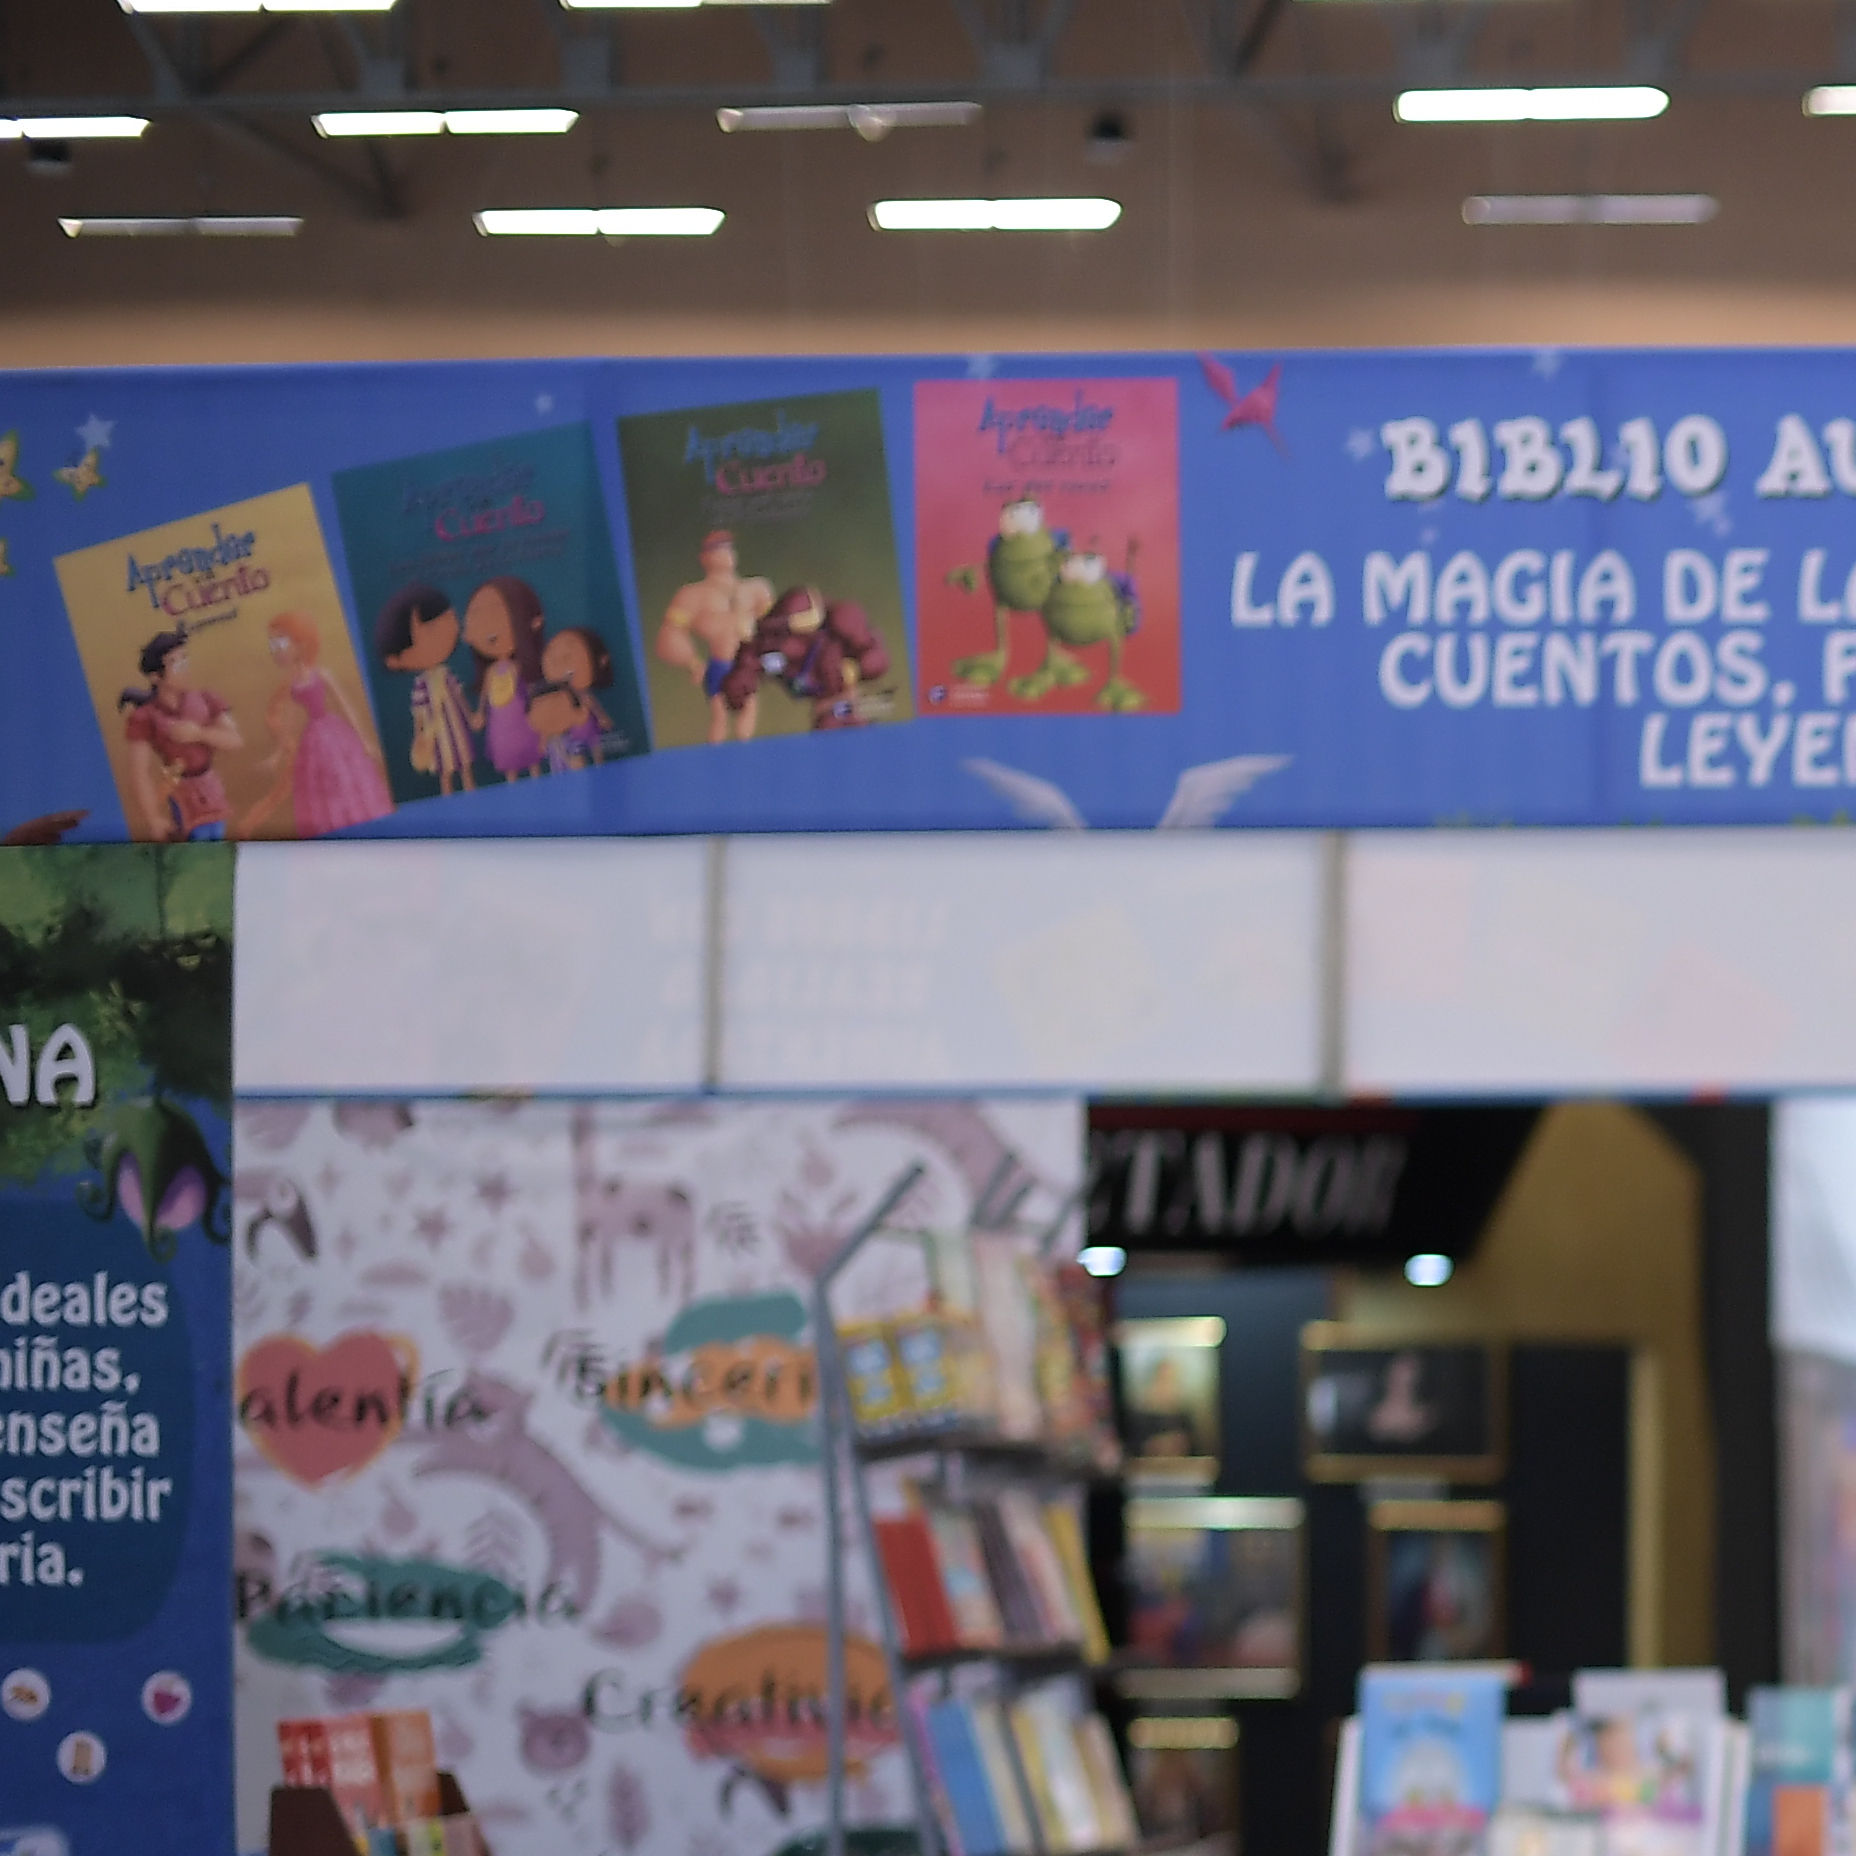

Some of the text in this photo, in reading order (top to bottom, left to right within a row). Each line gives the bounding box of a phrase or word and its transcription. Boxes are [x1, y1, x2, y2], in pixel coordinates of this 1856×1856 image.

[1380, 414, 1728, 501] BIBLIO
[1230, 551, 1336, 628] LA
[1361, 550, 1638, 627] MAGIA
[1662, 548, 1771, 624] DE
